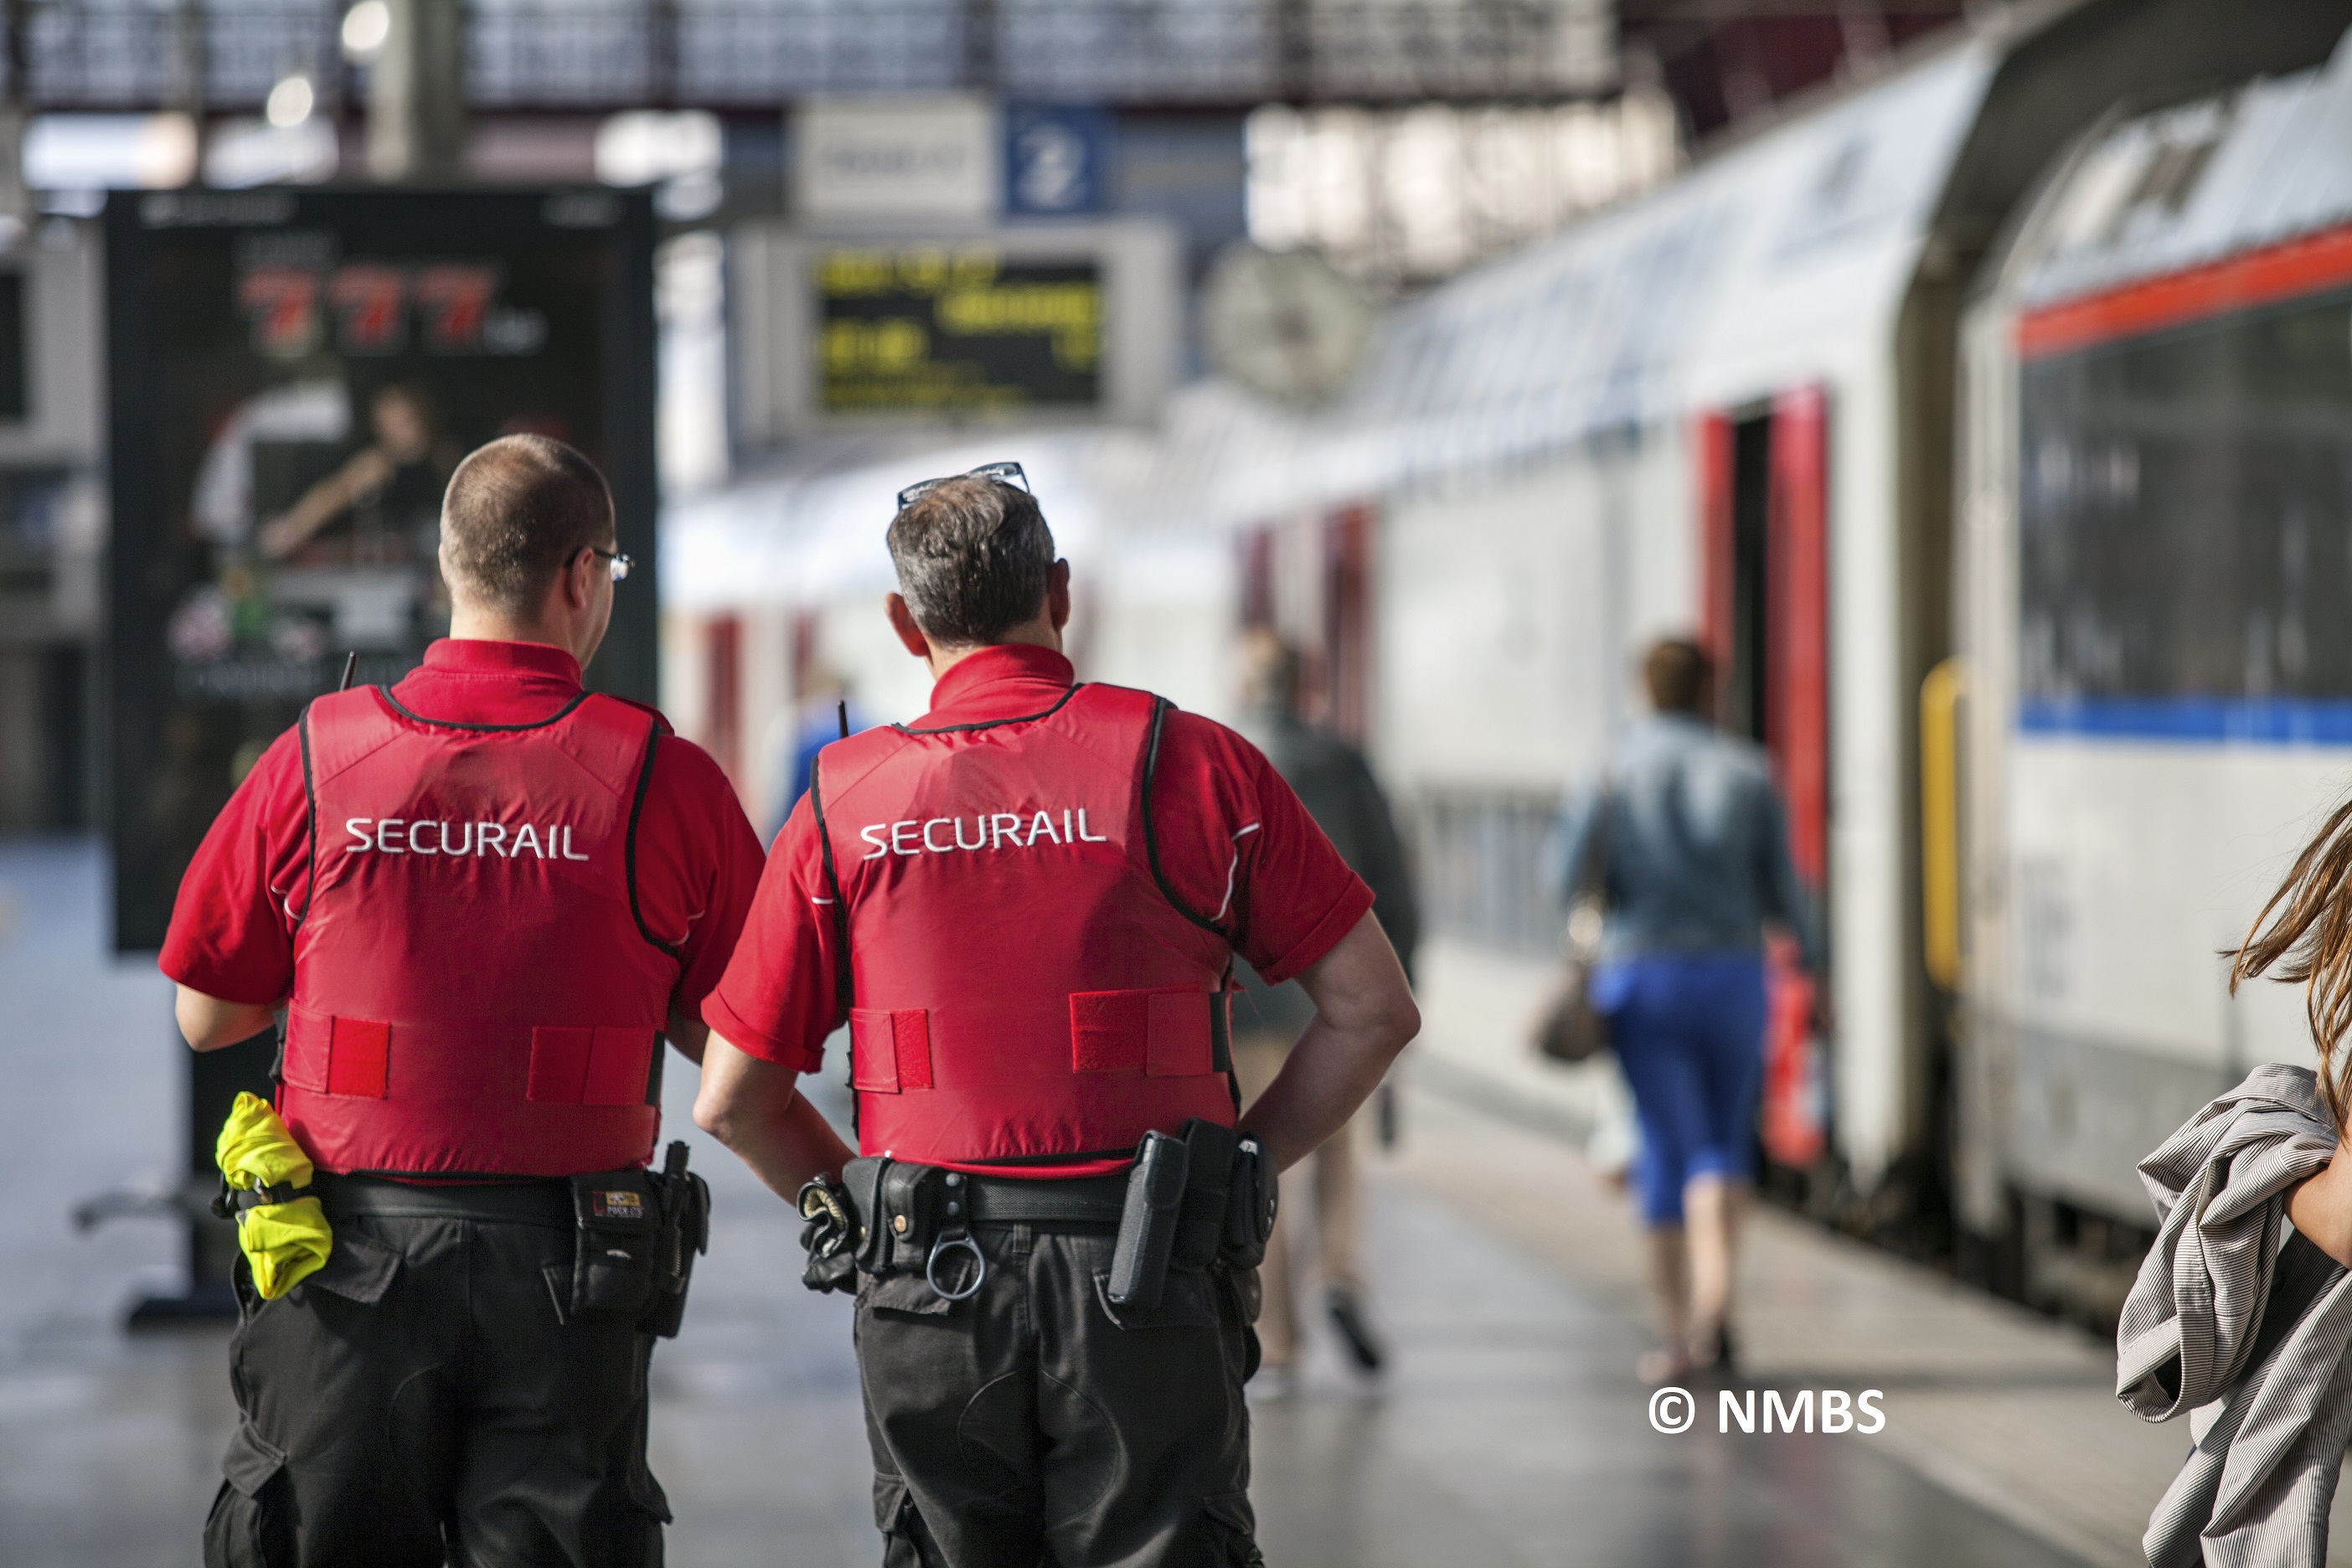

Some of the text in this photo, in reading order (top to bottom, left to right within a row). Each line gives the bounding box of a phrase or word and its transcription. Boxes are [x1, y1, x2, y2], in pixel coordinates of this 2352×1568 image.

[1017, 123, 1088, 209] 2
[344, 817, 589, 861] SECURAIL
[859, 807, 1107, 861] SECURAIL
